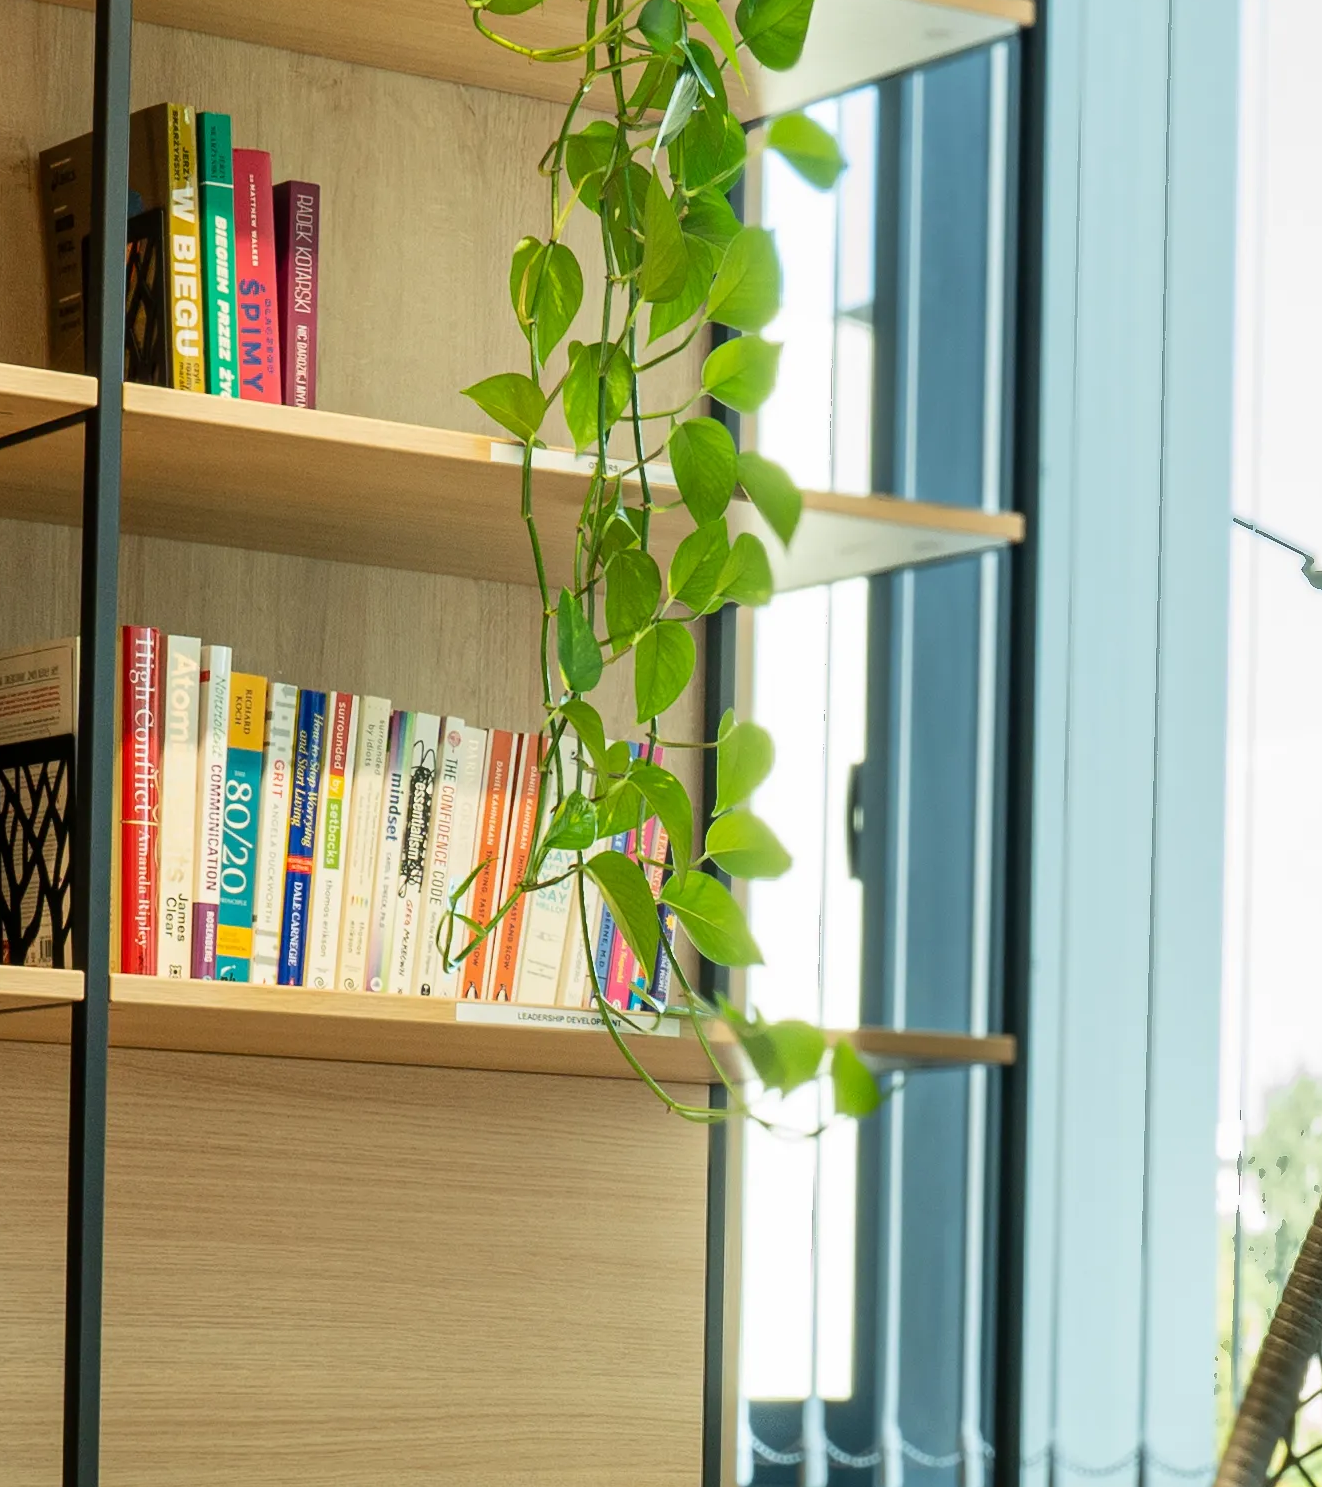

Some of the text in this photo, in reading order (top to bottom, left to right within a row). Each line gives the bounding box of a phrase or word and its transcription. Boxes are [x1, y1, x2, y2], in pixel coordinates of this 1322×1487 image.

[182, 146, 190, 182] JERZY
[249, 183, 259, 267] MATTHEW WALKER
[295, 193, 314, 244] RADEK
[170, 186, 199, 358] W BIEGU
[214, 215, 232, 361] BIEGIEM PRZEZ
[294, 246, 313, 314] KOTARSKI
[239, 278, 265, 394] ŚPIMY
[265, 298, 274, 374] DLACZEGO
[212, 674, 226, 758] Nonviolent
[235, 695, 244, 725] KOCH
[243, 688, 253, 735] RICHARD
[312, 713, 324, 743] How
[307, 759, 320, 787] Stop
[312, 745, 321, 757] to
[364, 724, 376, 767] by idiots
[374, 719, 386, 776] surrounded
[129, 638, 155, 947] High Conflict Amanda Ripley
[290, 730, 309, 828] and Start Living
[385, 772, 404, 842] mindset
[486, 760, 504, 846] DANIEL KAHNEMAN
[520, 765, 538, 850] DANIEL KAHNEMAN
[206, 764, 223, 891] COMMUNICATION
[220, 779, 252, 894] 80/20
[264, 759, 286, 924] GRIT ANGELA DUCKWORTH
[301, 790, 317, 848] Worrying
[320, 701, 348, 957] surrounded by setbacks thomas erikson
[429, 758, 458, 907] THE CONFIDENCE CODE
[292, 881, 304, 911] DALE
[398, 782, 426, 977] essentialism GREG McKEOWN
[478, 898, 487, 918] FAST
[165, 897, 178, 939] Clear
[177, 893, 190, 943] James
[288, 911, 302, 967] CARNEGIE
[356, 921, 366, 955] thomas
[507, 923, 515, 942] AND
[503, 945, 512, 970] SLOW
[517, 1012, 565, 1023] LEADERSHIP
